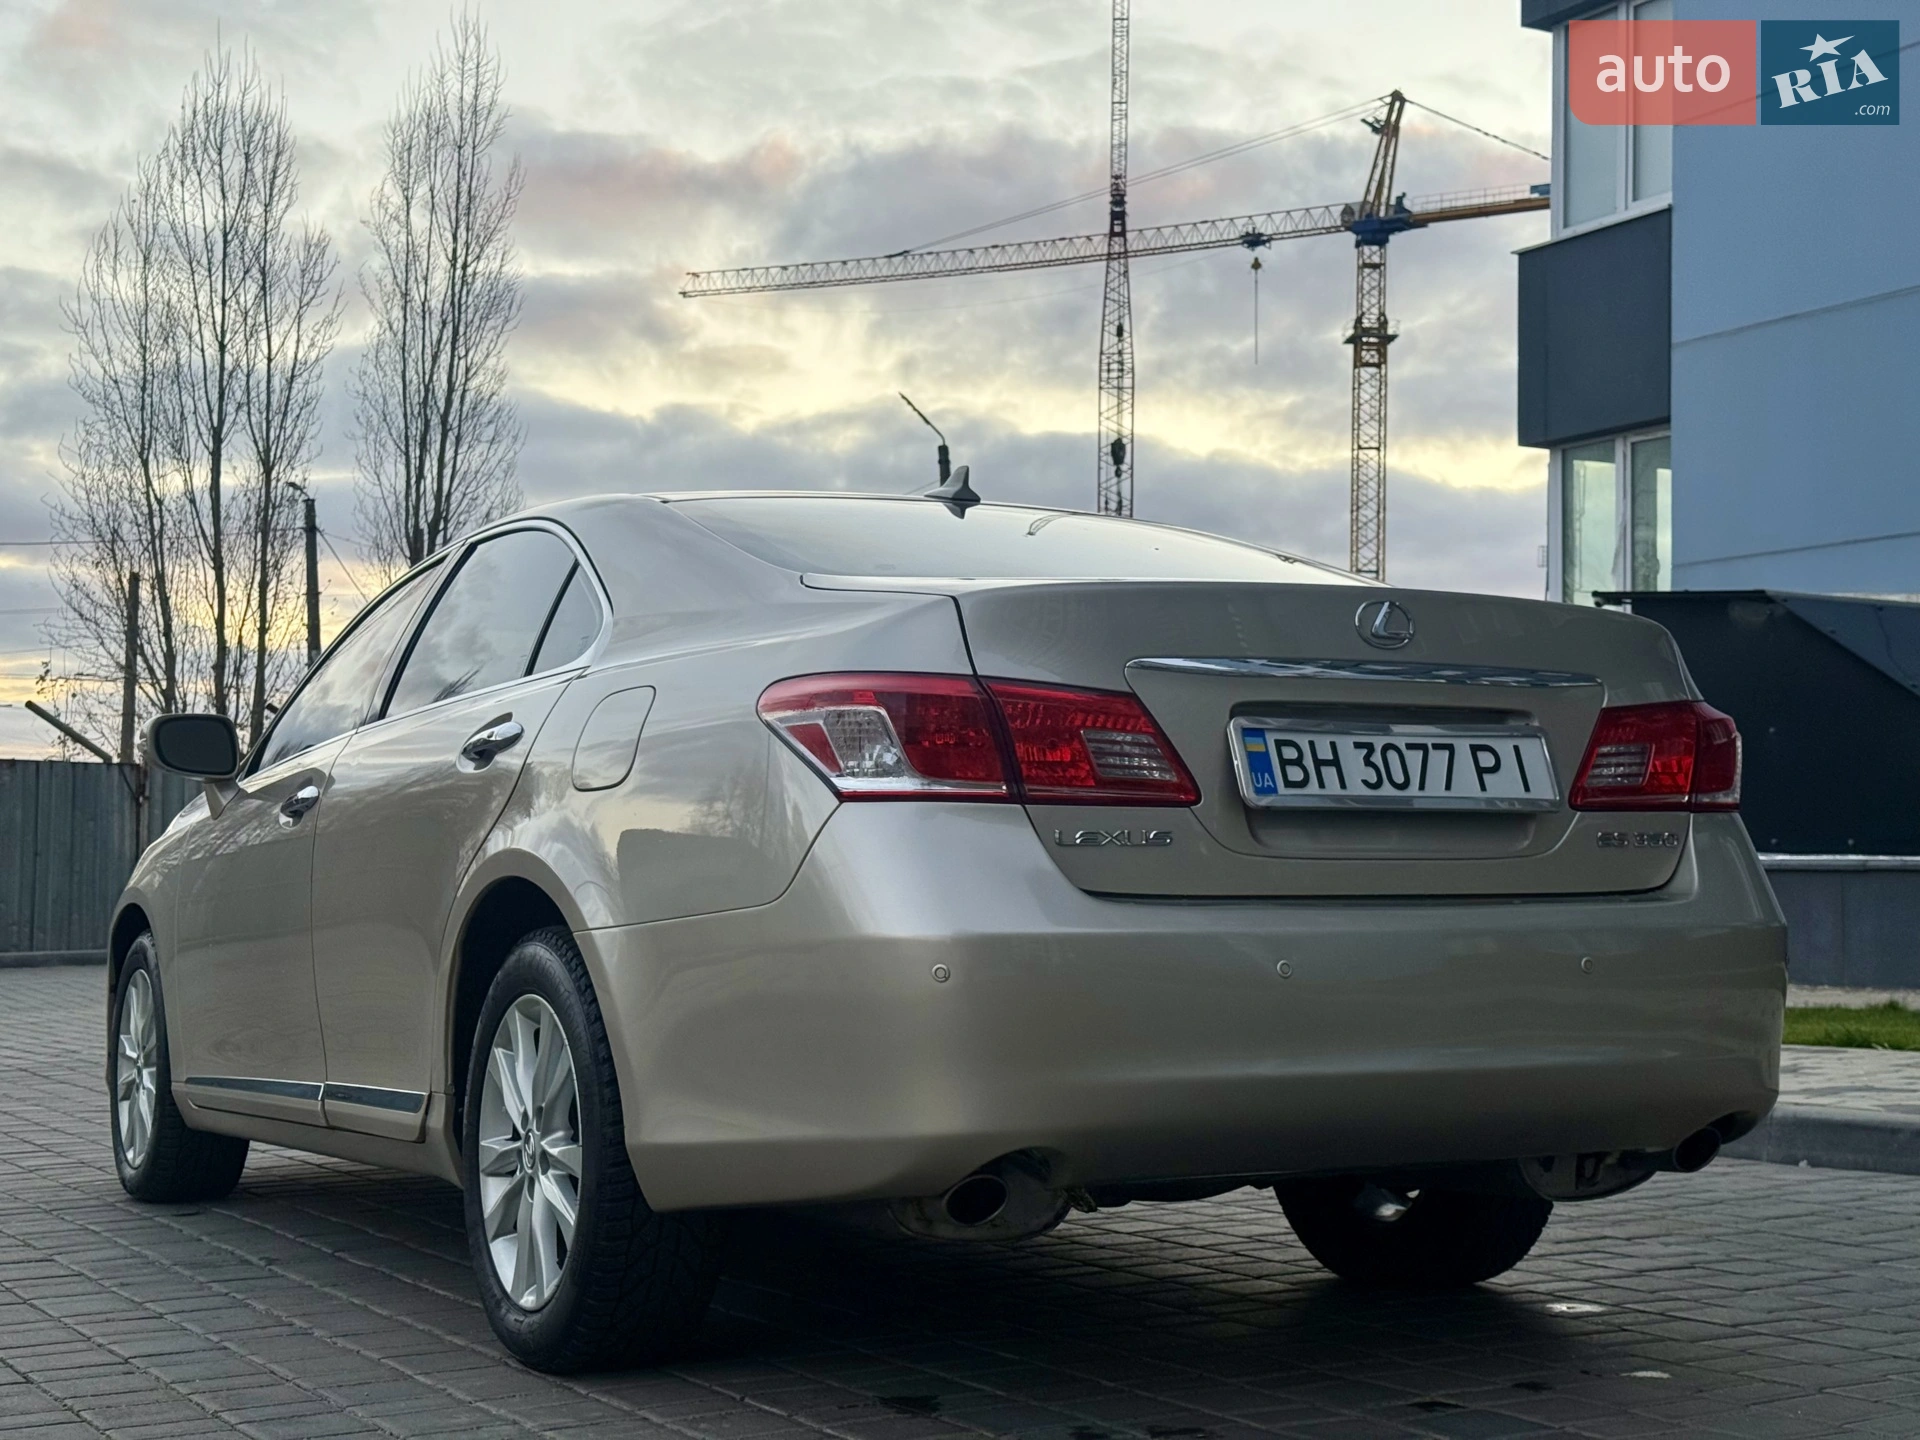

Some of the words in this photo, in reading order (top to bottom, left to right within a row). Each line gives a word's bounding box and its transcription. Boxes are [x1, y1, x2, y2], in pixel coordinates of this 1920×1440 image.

[1273, 738, 1347, 790] BH
[1352, 741, 1456, 792] 3077
[1468, 743, 1531, 793] PI
[1252, 771, 1275, 789] UA
[1054, 829, 1174, 847] LEXUS
[1597, 831, 1629, 848] ES
